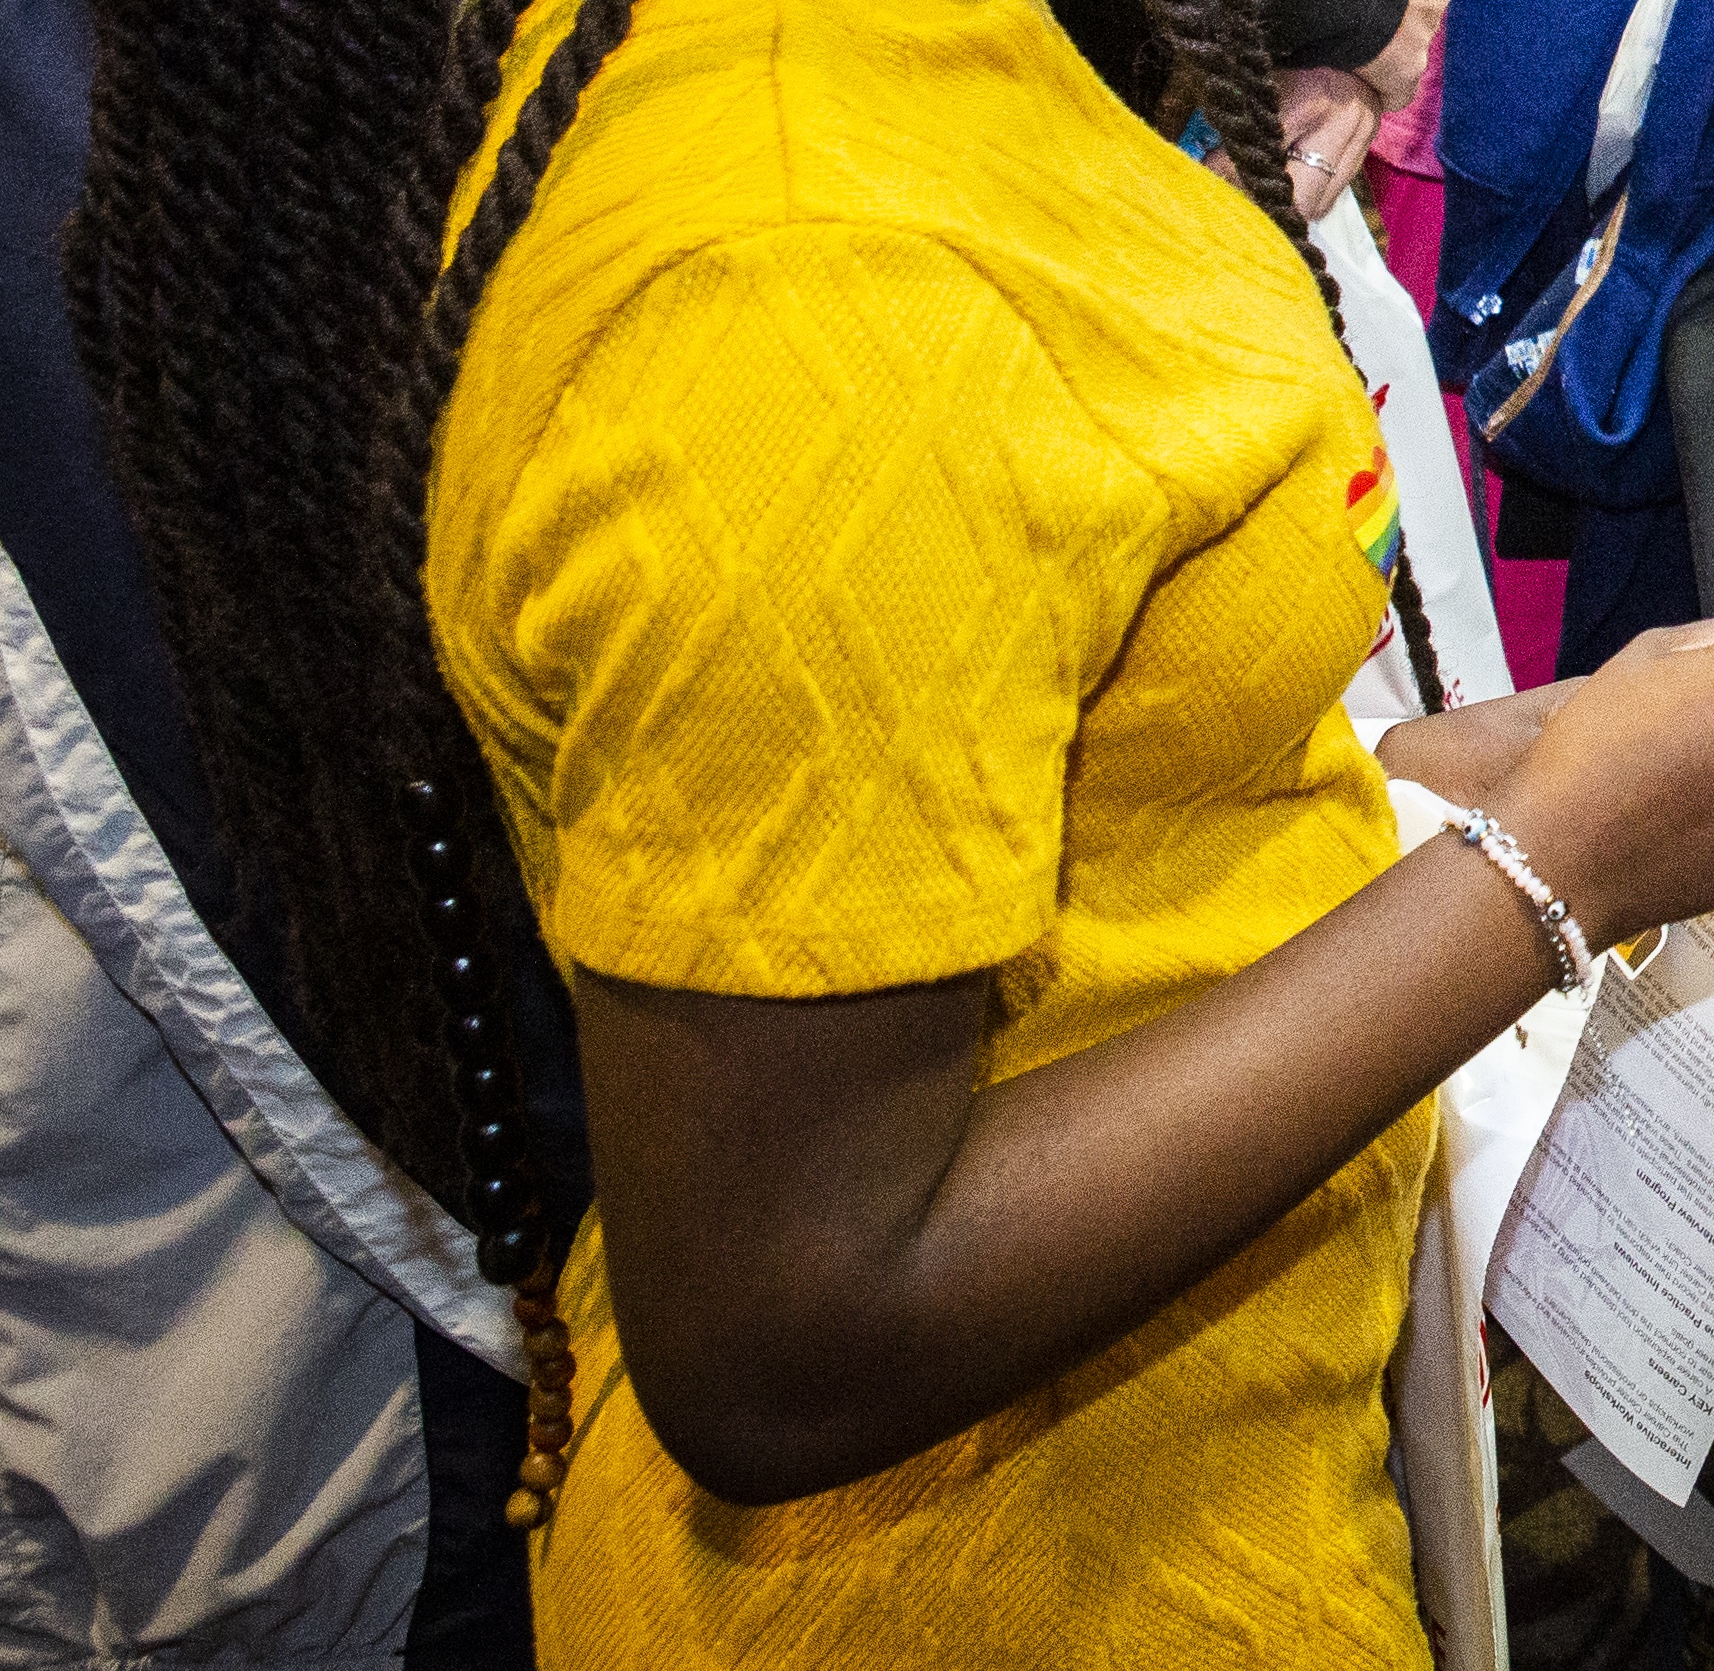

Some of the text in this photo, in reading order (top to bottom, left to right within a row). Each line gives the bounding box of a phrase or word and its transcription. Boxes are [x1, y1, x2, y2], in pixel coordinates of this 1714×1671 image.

[1689, 1036, 1705, 1055] and
[1654, 1113, 1670, 1133] and
[1657, 1134, 1682, 1160] These
[1658, 1150, 1706, 1196] professional
[1634, 1165, 1677, 1212] Program
[1676, 1182, 1692, 1201] that
[1622, 1214, 1637, 1232] can
[1614, 1222, 1653, 1264] responses
[1636, 1228, 1661, 1255] which
[1612, 1240, 1659, 1292] Interviews
[1653, 1260, 1671, 1280] their
[1660, 1250, 1679, 1271] Link
[1671, 1276, 1699, 1303] record
[1679, 1266, 1707, 1297] Career
[1616, 1309, 1632, 1328] tool
[1620, 1297, 1639, 1319] dots
[1660, 1286, 1702, 1329] Practice
[1638, 1314, 1653, 1331] the
[1631, 1324, 1676, 1366] exploration
[1653, 1327, 1687, 1360] connect
[1676, 1362, 1704, 1388] career
[1686, 1355, 1697, 1369] to
[1591, 1344, 1694, 1439] workshops on professional
[1647, 1356, 1713, 1416] KEY Careers
[1703, 1384, 1712, 1397] A
[1615, 1385, 1642, 1415] Center
[1582, 1368, 1691, 1470] Interactive Workshops
[1642, 1409, 1671, 1439] Career
[1671, 1434, 1689, 1452] The
